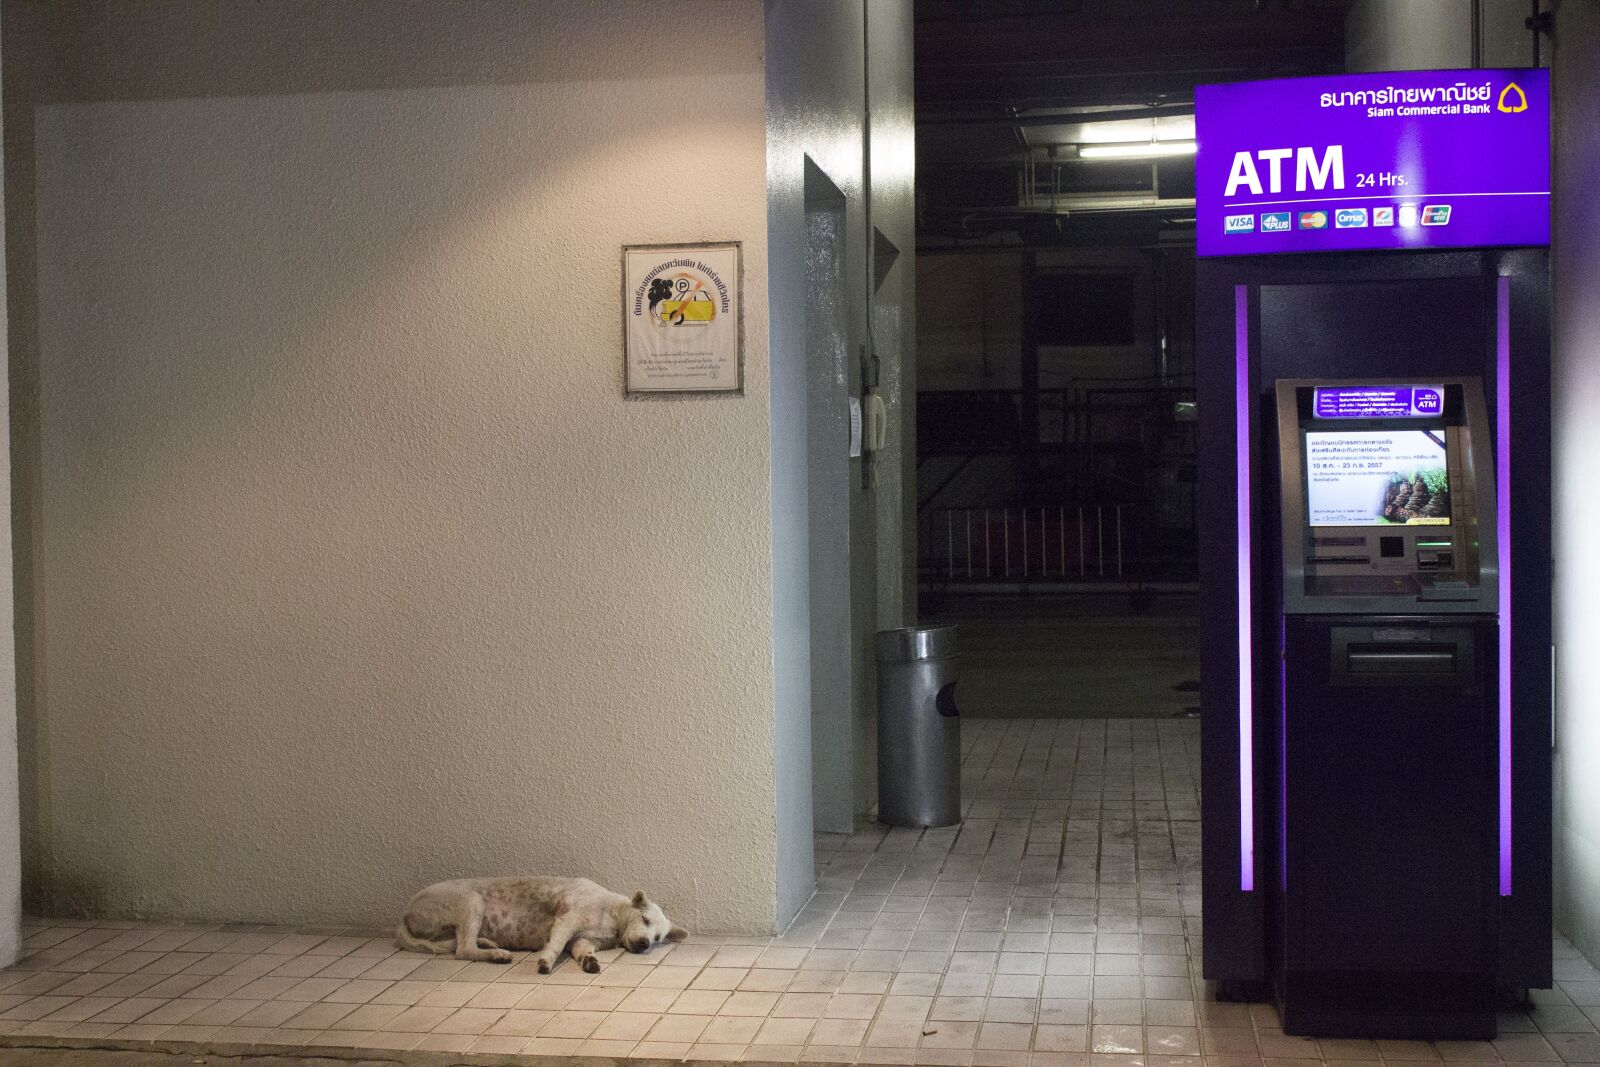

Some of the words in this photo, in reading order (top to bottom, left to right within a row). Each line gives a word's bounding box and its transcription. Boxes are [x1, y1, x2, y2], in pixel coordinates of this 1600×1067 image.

[1320, 82, 1491, 107] ธนาคารไทยพาณิชย์
[1367, 106, 1394, 117] Siam
[1397, 104, 1460, 116] Commercial
[1463, 103, 1491, 114] Bank
[1223, 145, 1345, 197] ATM
[1356, 173, 1375, 188] 24
[1379, 172, 1409, 187] Hrs.
[1229, 217, 1254, 228] VISA
[1338, 213, 1363, 223] Cirrus
[1270, 221, 1289, 230] PLUS
[679, 282, 687, 290] P
[1418, 400, 1436, 408] ATM
